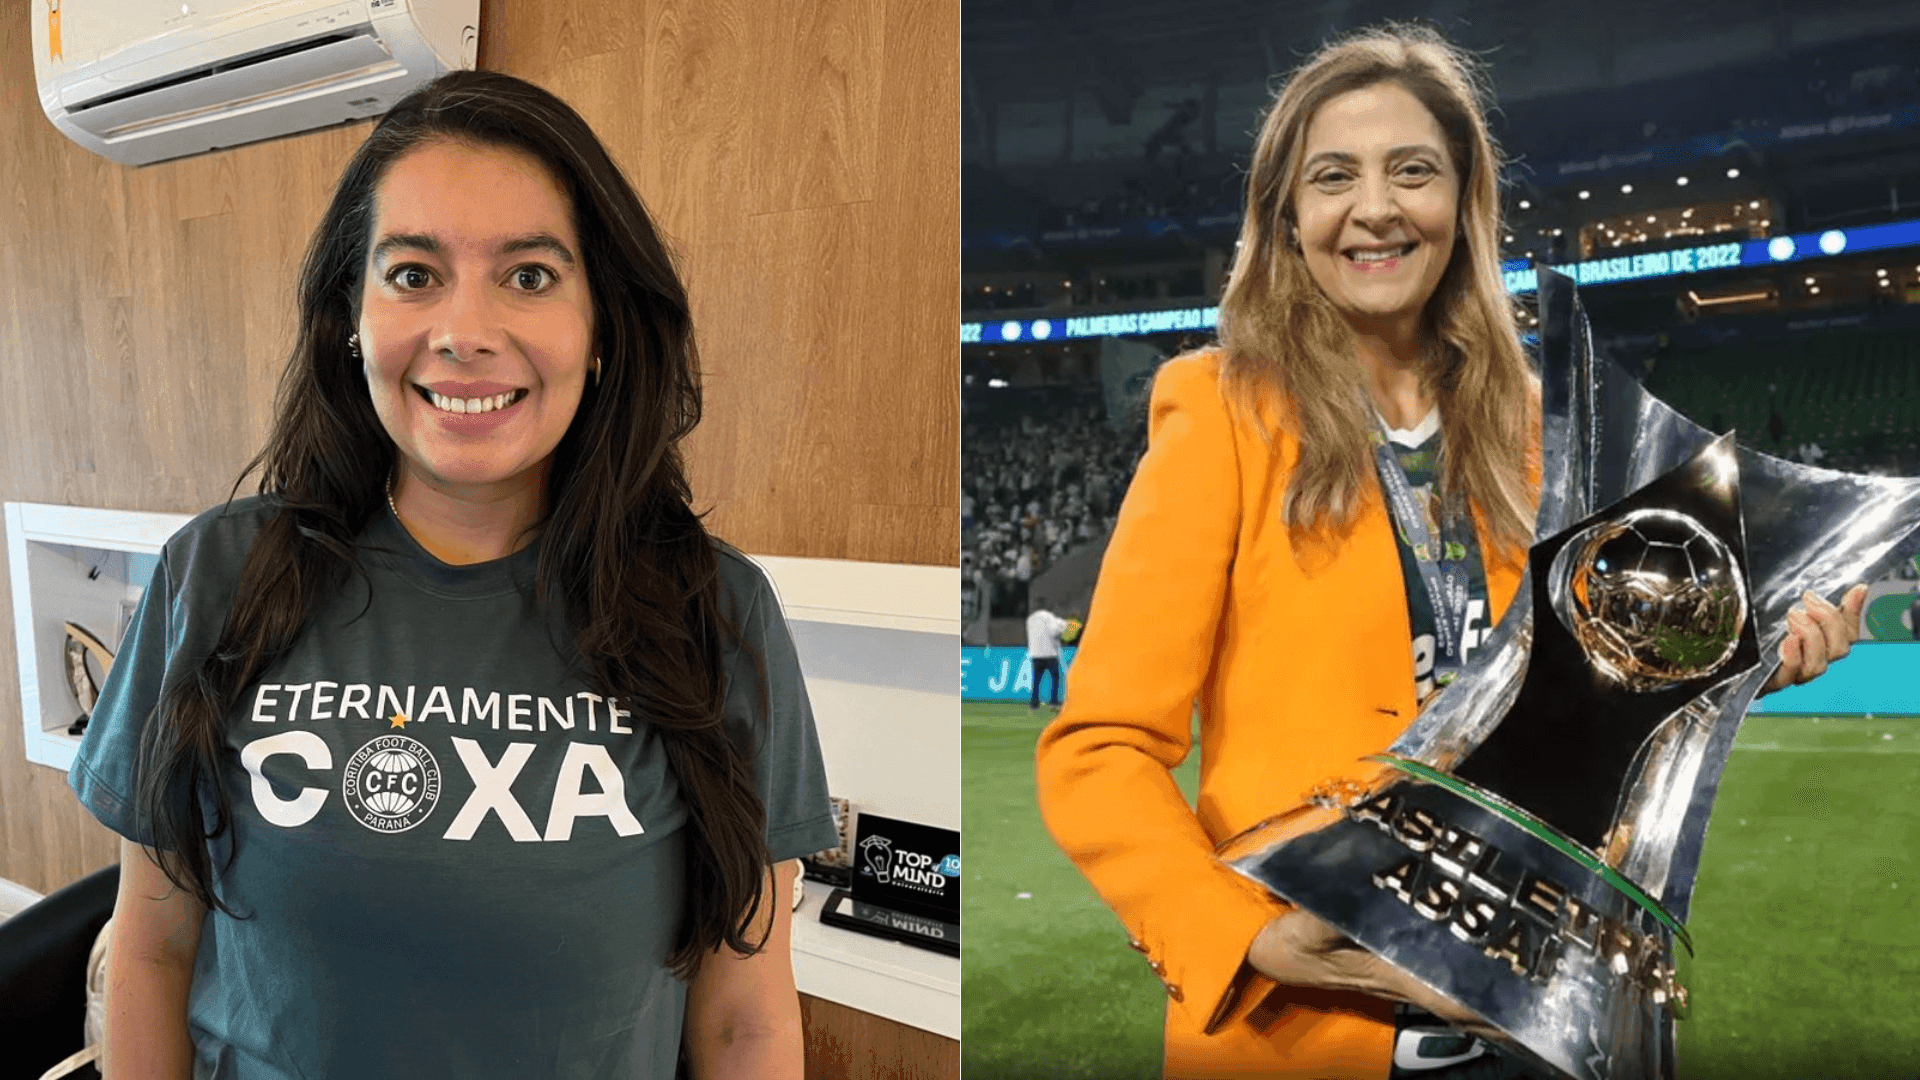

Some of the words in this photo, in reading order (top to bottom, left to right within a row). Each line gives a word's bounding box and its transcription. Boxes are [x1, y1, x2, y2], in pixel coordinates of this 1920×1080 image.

[1579, 251, 1670, 284] BRASILEIRO
[1672, 248, 1694, 272] DE
[1695, 243, 1741, 269] 2022
[251, 681, 633, 734] ETERNAMENTE
[346, 746, 375, 796] CORITIBA
[375, 738, 406, 750] FOOT
[407, 742, 432, 768] BALL
[425, 769, 438, 801] CLUB
[365, 770, 418, 795] CFC
[895, 849, 933, 869] TOP
[892, 865, 946, 888] MIND
